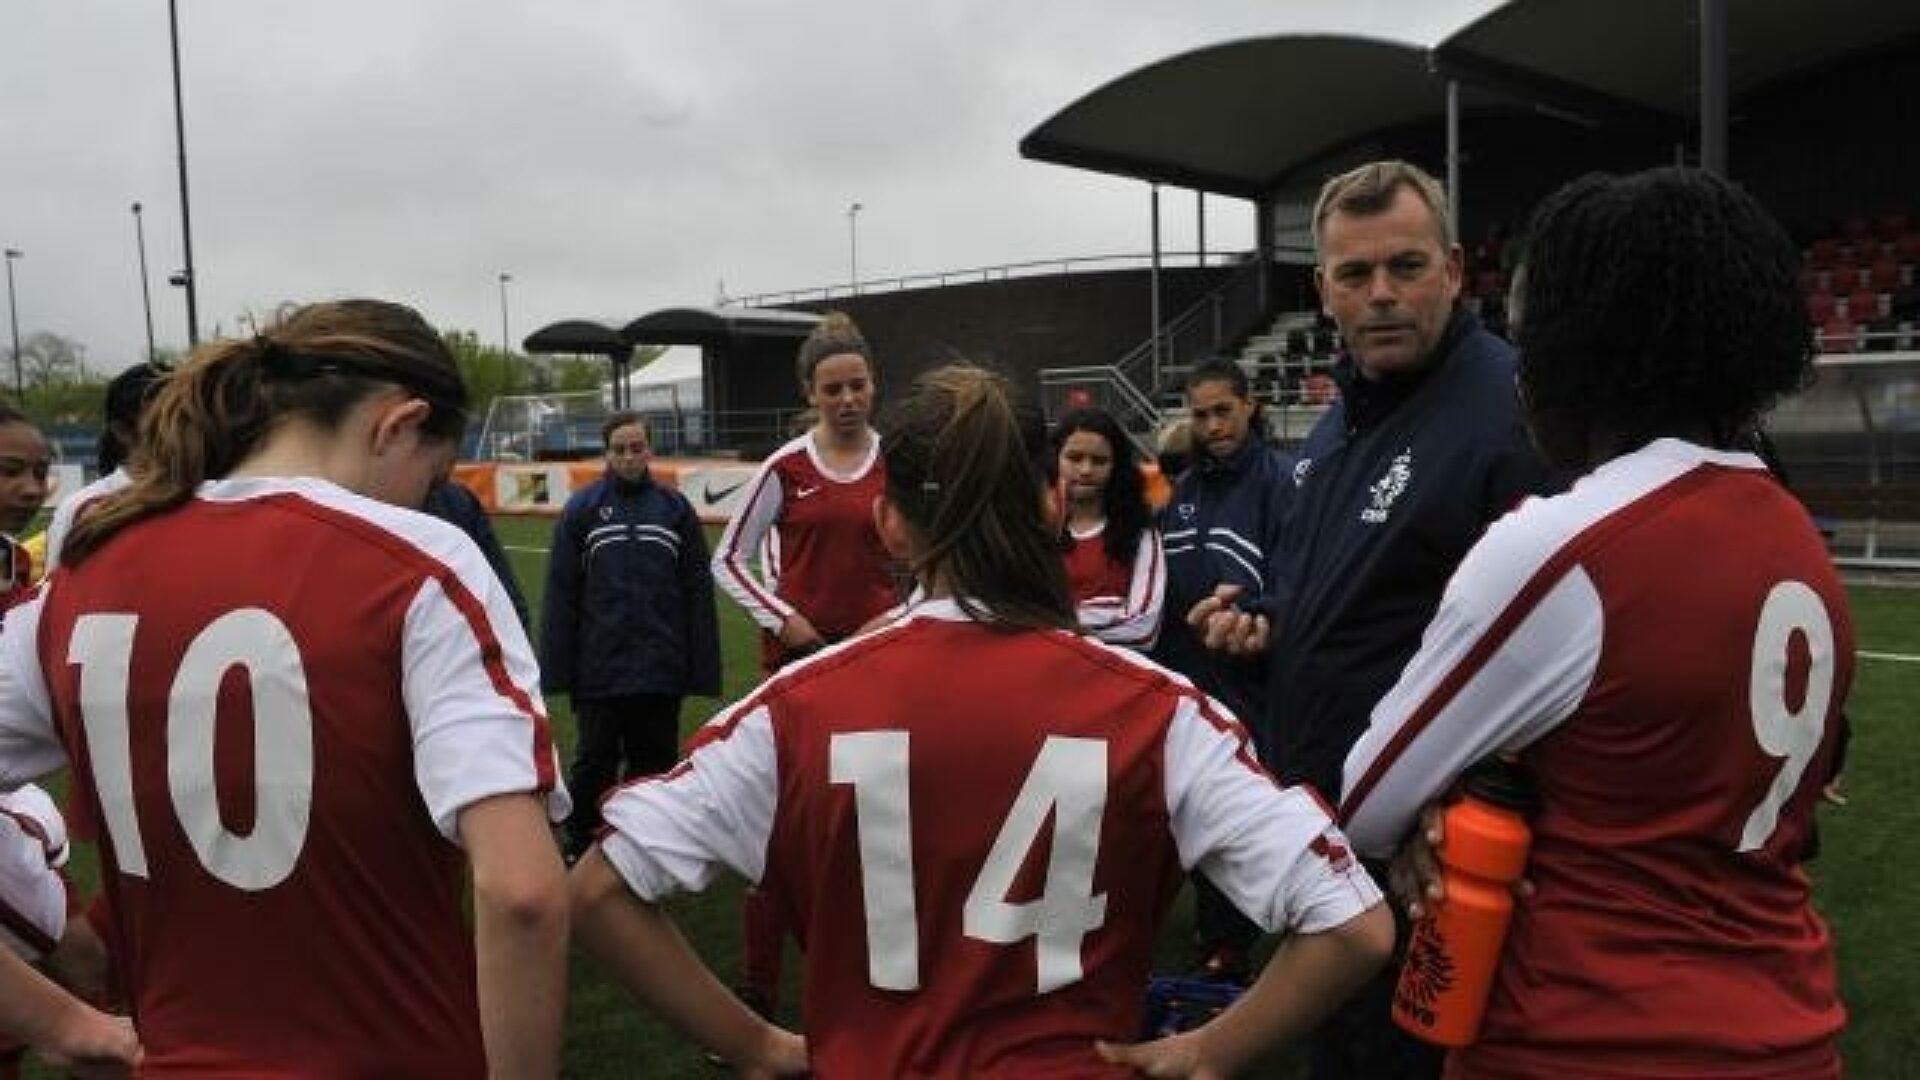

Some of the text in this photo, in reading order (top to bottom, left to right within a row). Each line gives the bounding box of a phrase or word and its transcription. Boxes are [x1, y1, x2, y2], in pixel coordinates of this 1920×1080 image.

[67, 608, 313, 891] 10
[1736, 580, 1834, 852] 9
[829, 730, 1108, 993] 14
